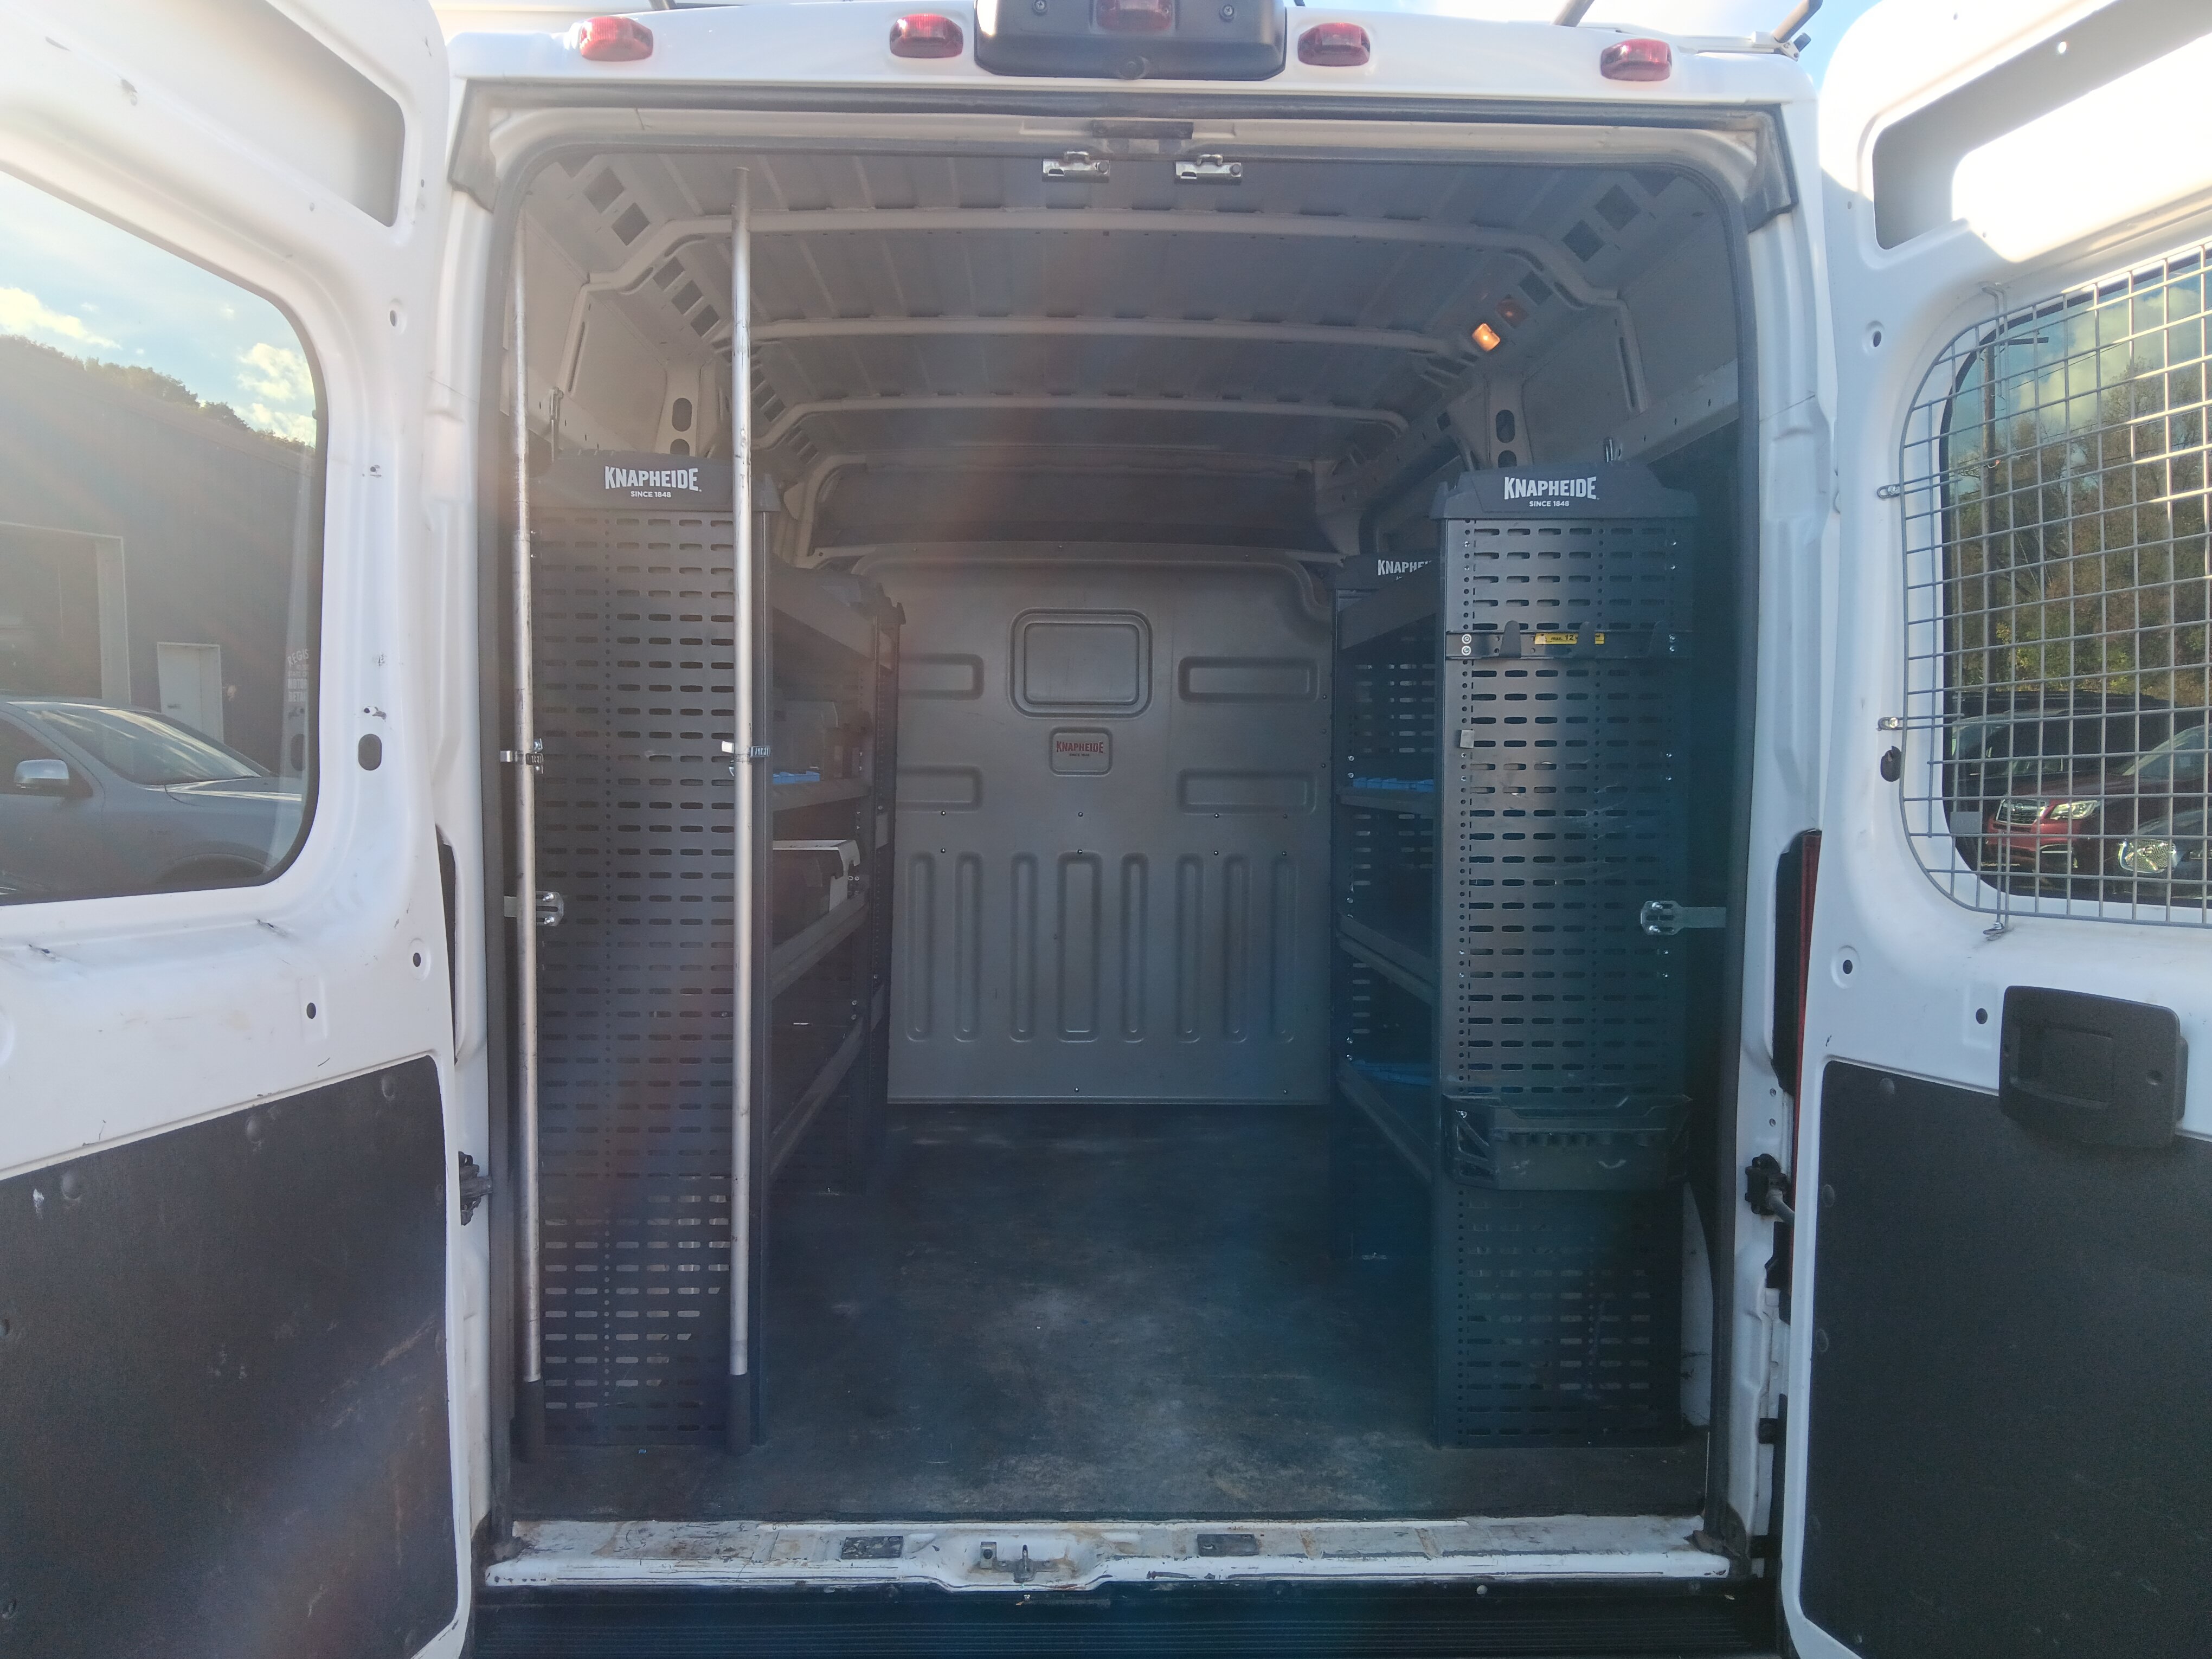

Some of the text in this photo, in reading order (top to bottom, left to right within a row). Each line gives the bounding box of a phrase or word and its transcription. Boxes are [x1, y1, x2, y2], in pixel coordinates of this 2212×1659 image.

[605, 466, 698, 491] KNAPHEIDE
[1504, 476, 1597, 500] KNAPHEIDE
[1378, 559, 1432, 576] KNAPHE
[1056, 741, 1104, 754] KNAPHEIDE
